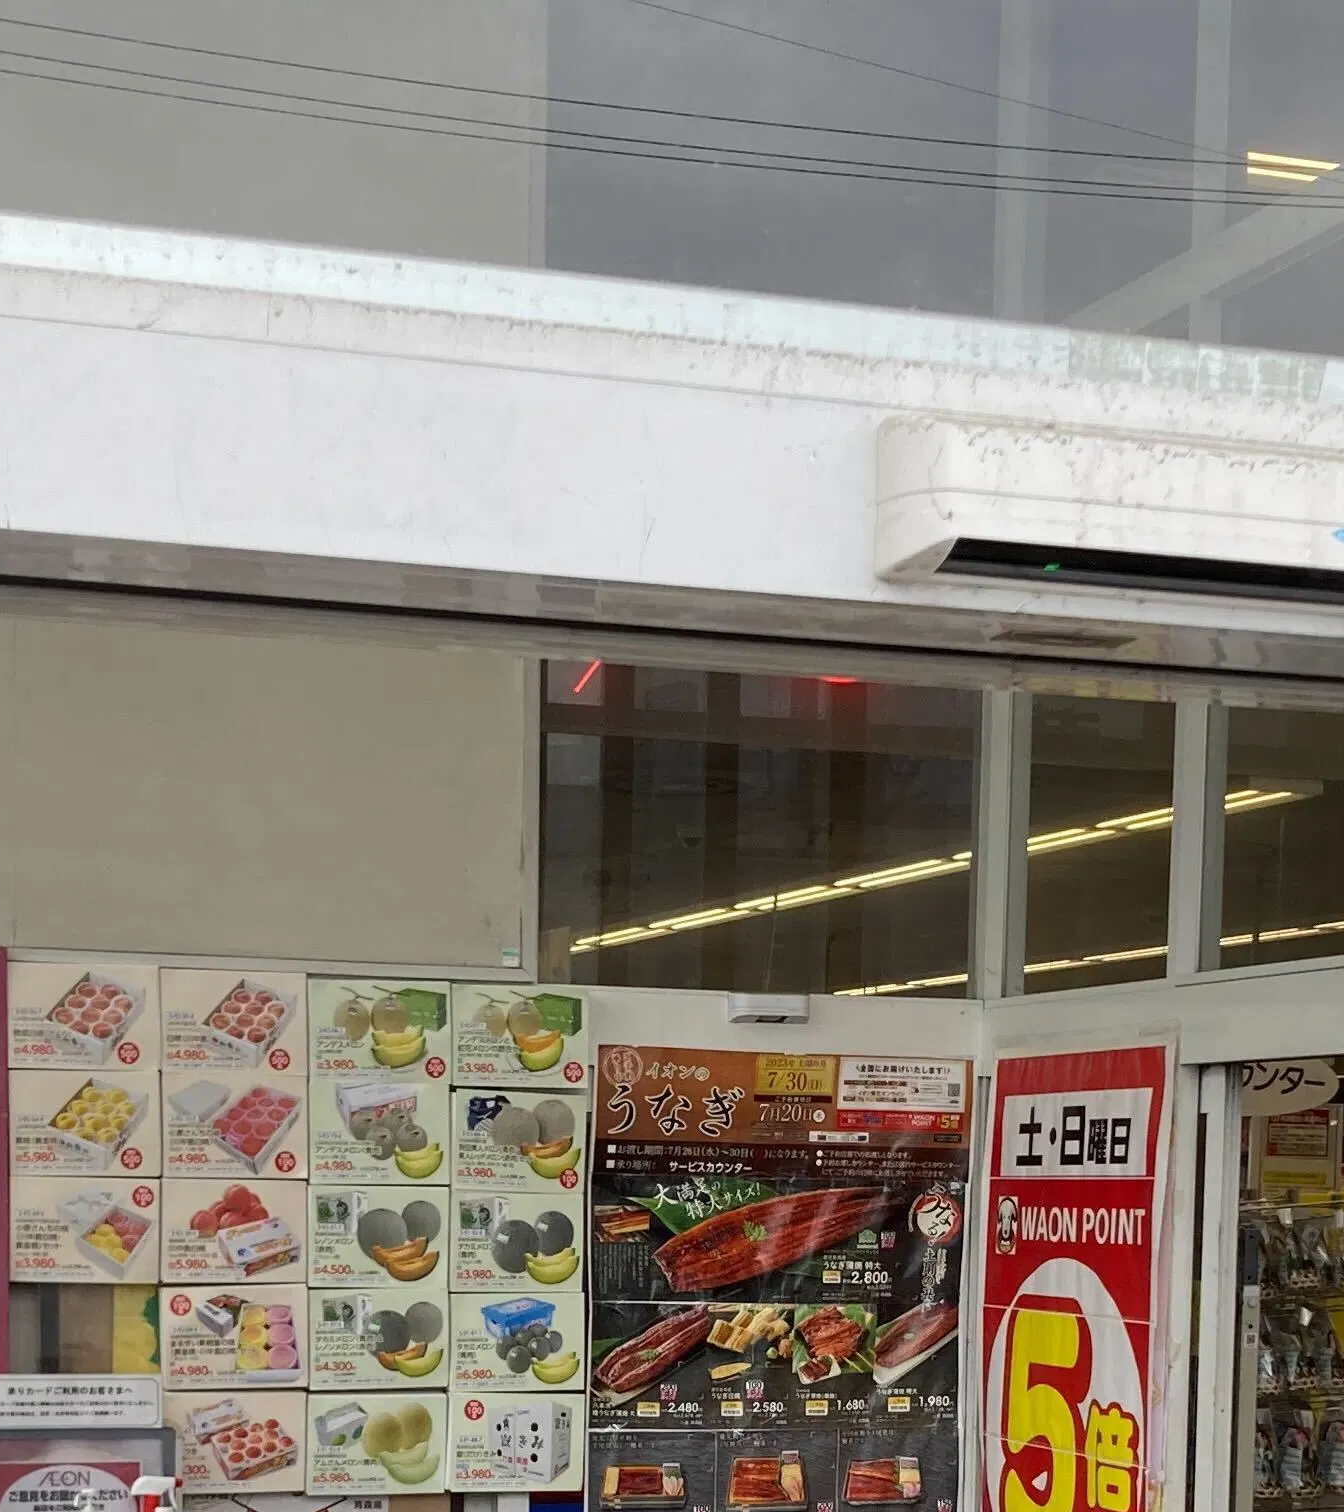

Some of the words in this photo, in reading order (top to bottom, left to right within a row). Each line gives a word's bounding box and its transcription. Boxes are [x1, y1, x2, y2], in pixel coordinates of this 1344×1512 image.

[645, 1062, 710, 1081] イオンの
[607, 1083, 745, 1137] うなぎ
[1016, 1106, 1131, 1166] 土・日曜日
[669, 1161, 753, 1174] サービスカウンター
[1021, 1206, 1077, 1243] WAON
[1082, 1207, 1145, 1245] POINT
